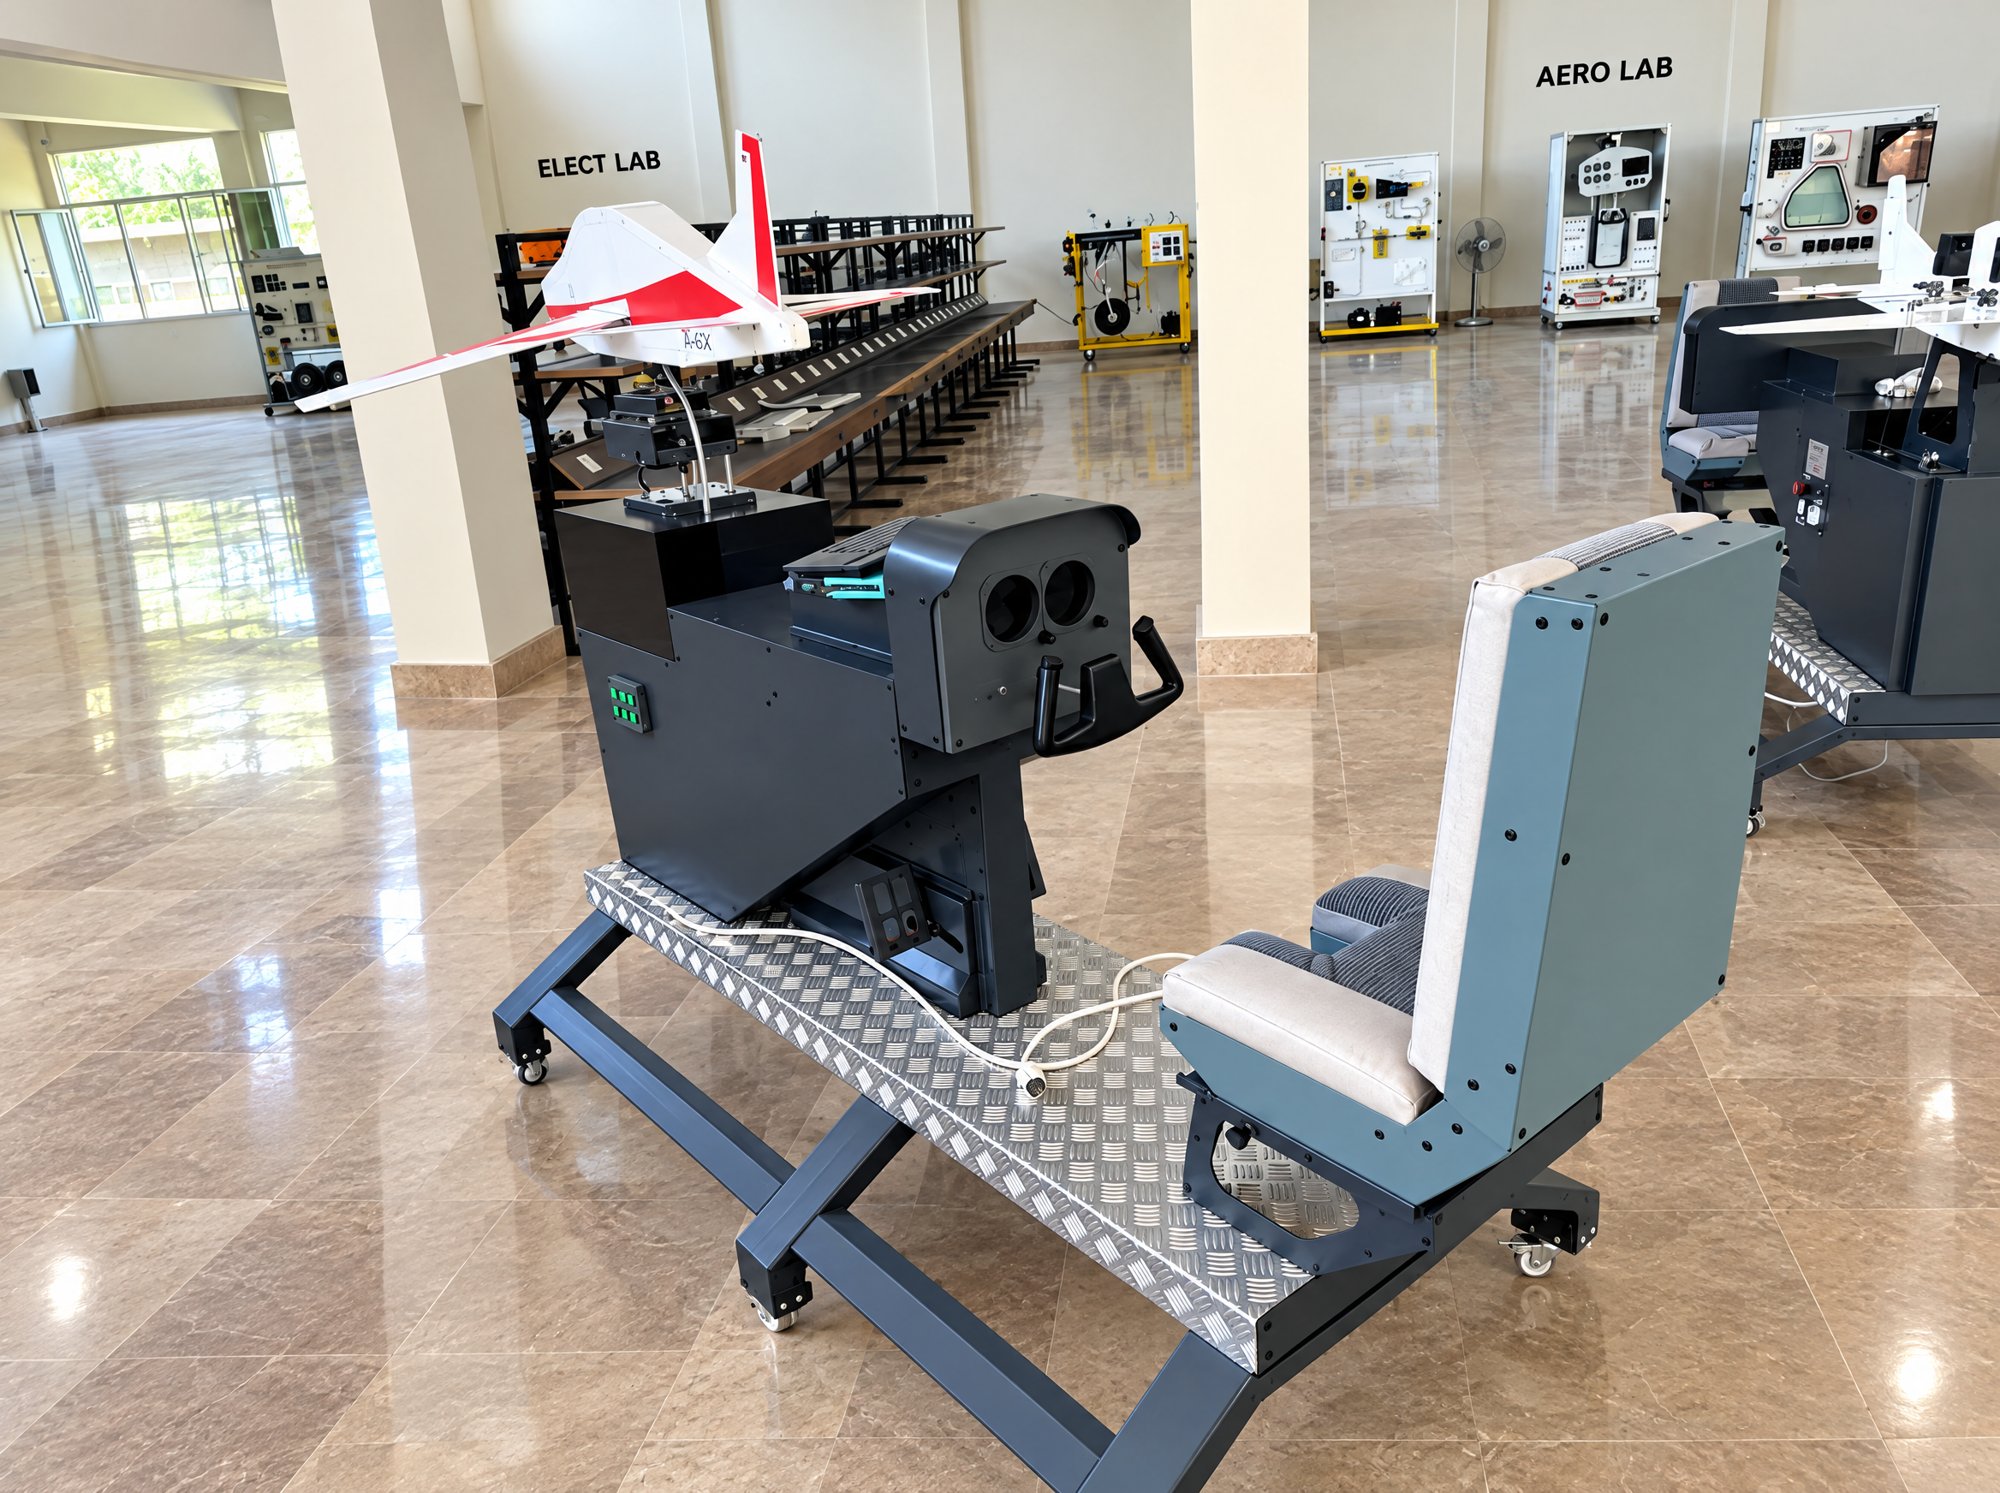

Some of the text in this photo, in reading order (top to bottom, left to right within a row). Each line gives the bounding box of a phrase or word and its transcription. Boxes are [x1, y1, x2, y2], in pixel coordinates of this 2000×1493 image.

[1535, 56, 1673, 88] AERO LAB
[537, 150, 661, 179] ELECT LAB
